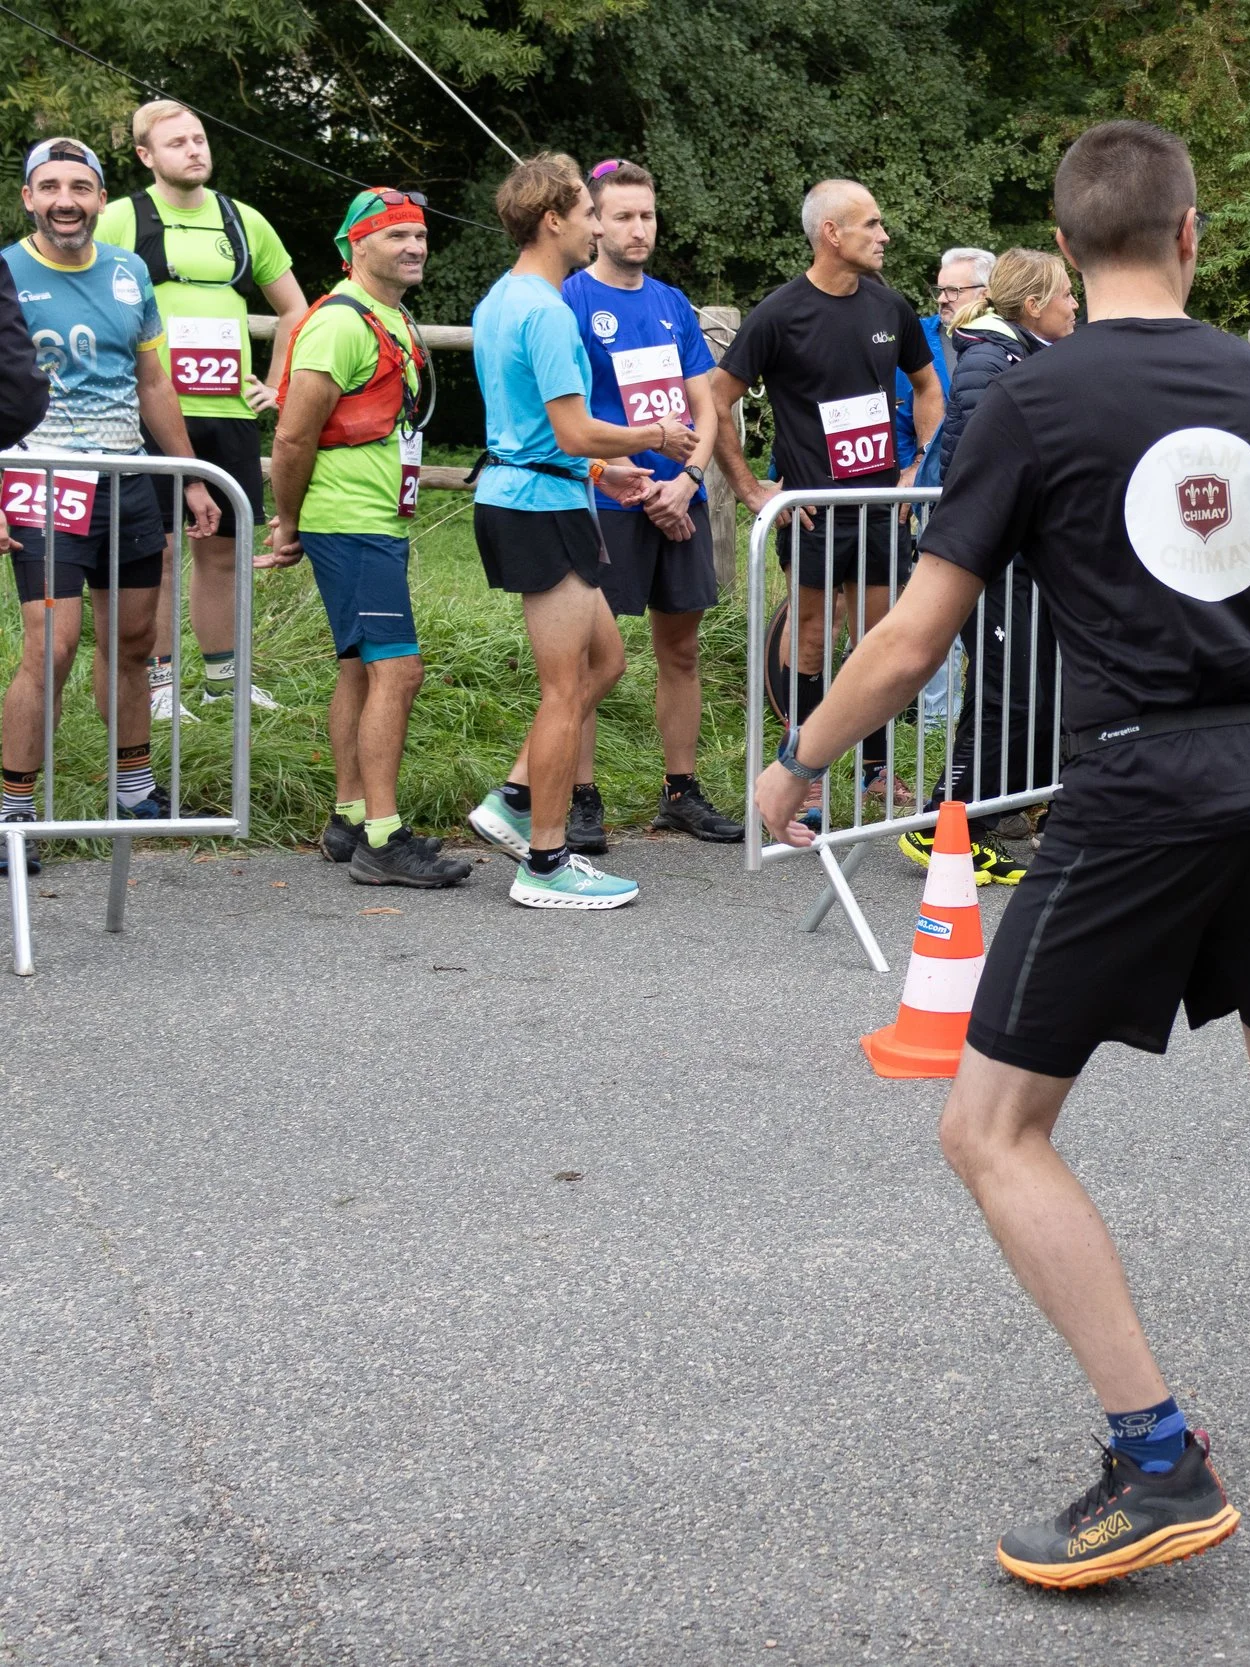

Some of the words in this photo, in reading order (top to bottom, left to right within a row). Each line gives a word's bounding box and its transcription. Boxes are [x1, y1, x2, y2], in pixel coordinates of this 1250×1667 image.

[177, 357, 239, 384] 322
[629, 387, 686, 422] 298
[834, 432, 889, 467] 307
[5, 482, 88, 521] 255
[1183, 507, 1226, 522] CHIMAY
[1067, 1509, 1133, 1558] HOKA
